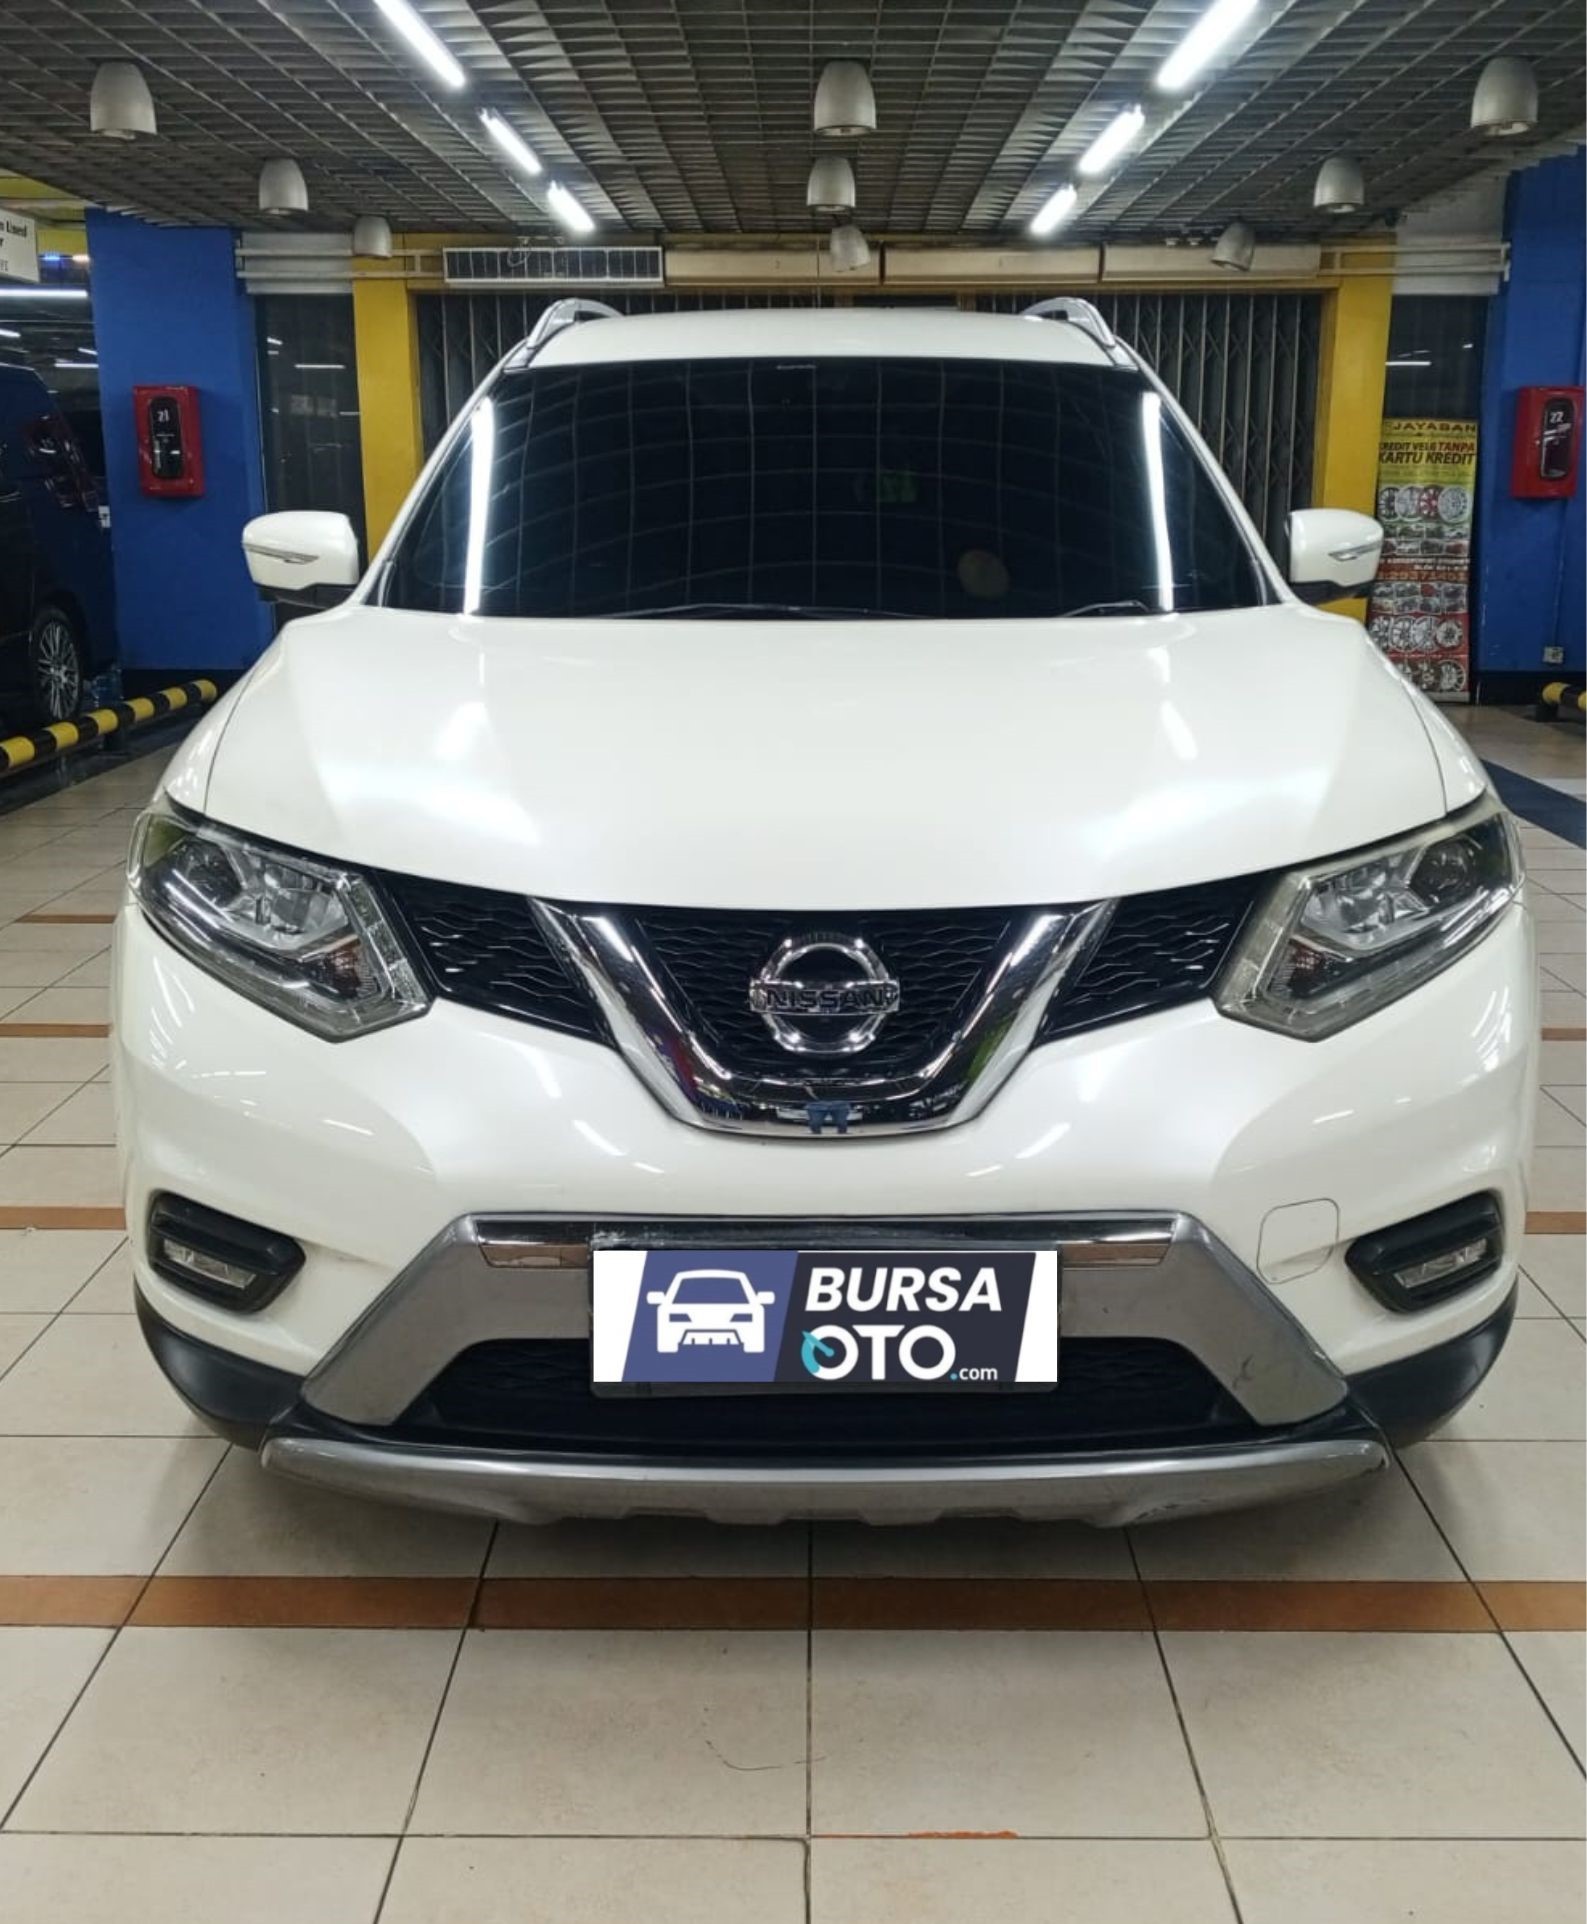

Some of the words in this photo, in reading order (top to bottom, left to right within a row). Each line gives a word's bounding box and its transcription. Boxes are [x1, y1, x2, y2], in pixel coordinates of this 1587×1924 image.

[1438, 441, 1475, 453] TANPA
[1424, 451, 1476, 466] KREDIT
[766, 988, 885, 1009] NISSAN
